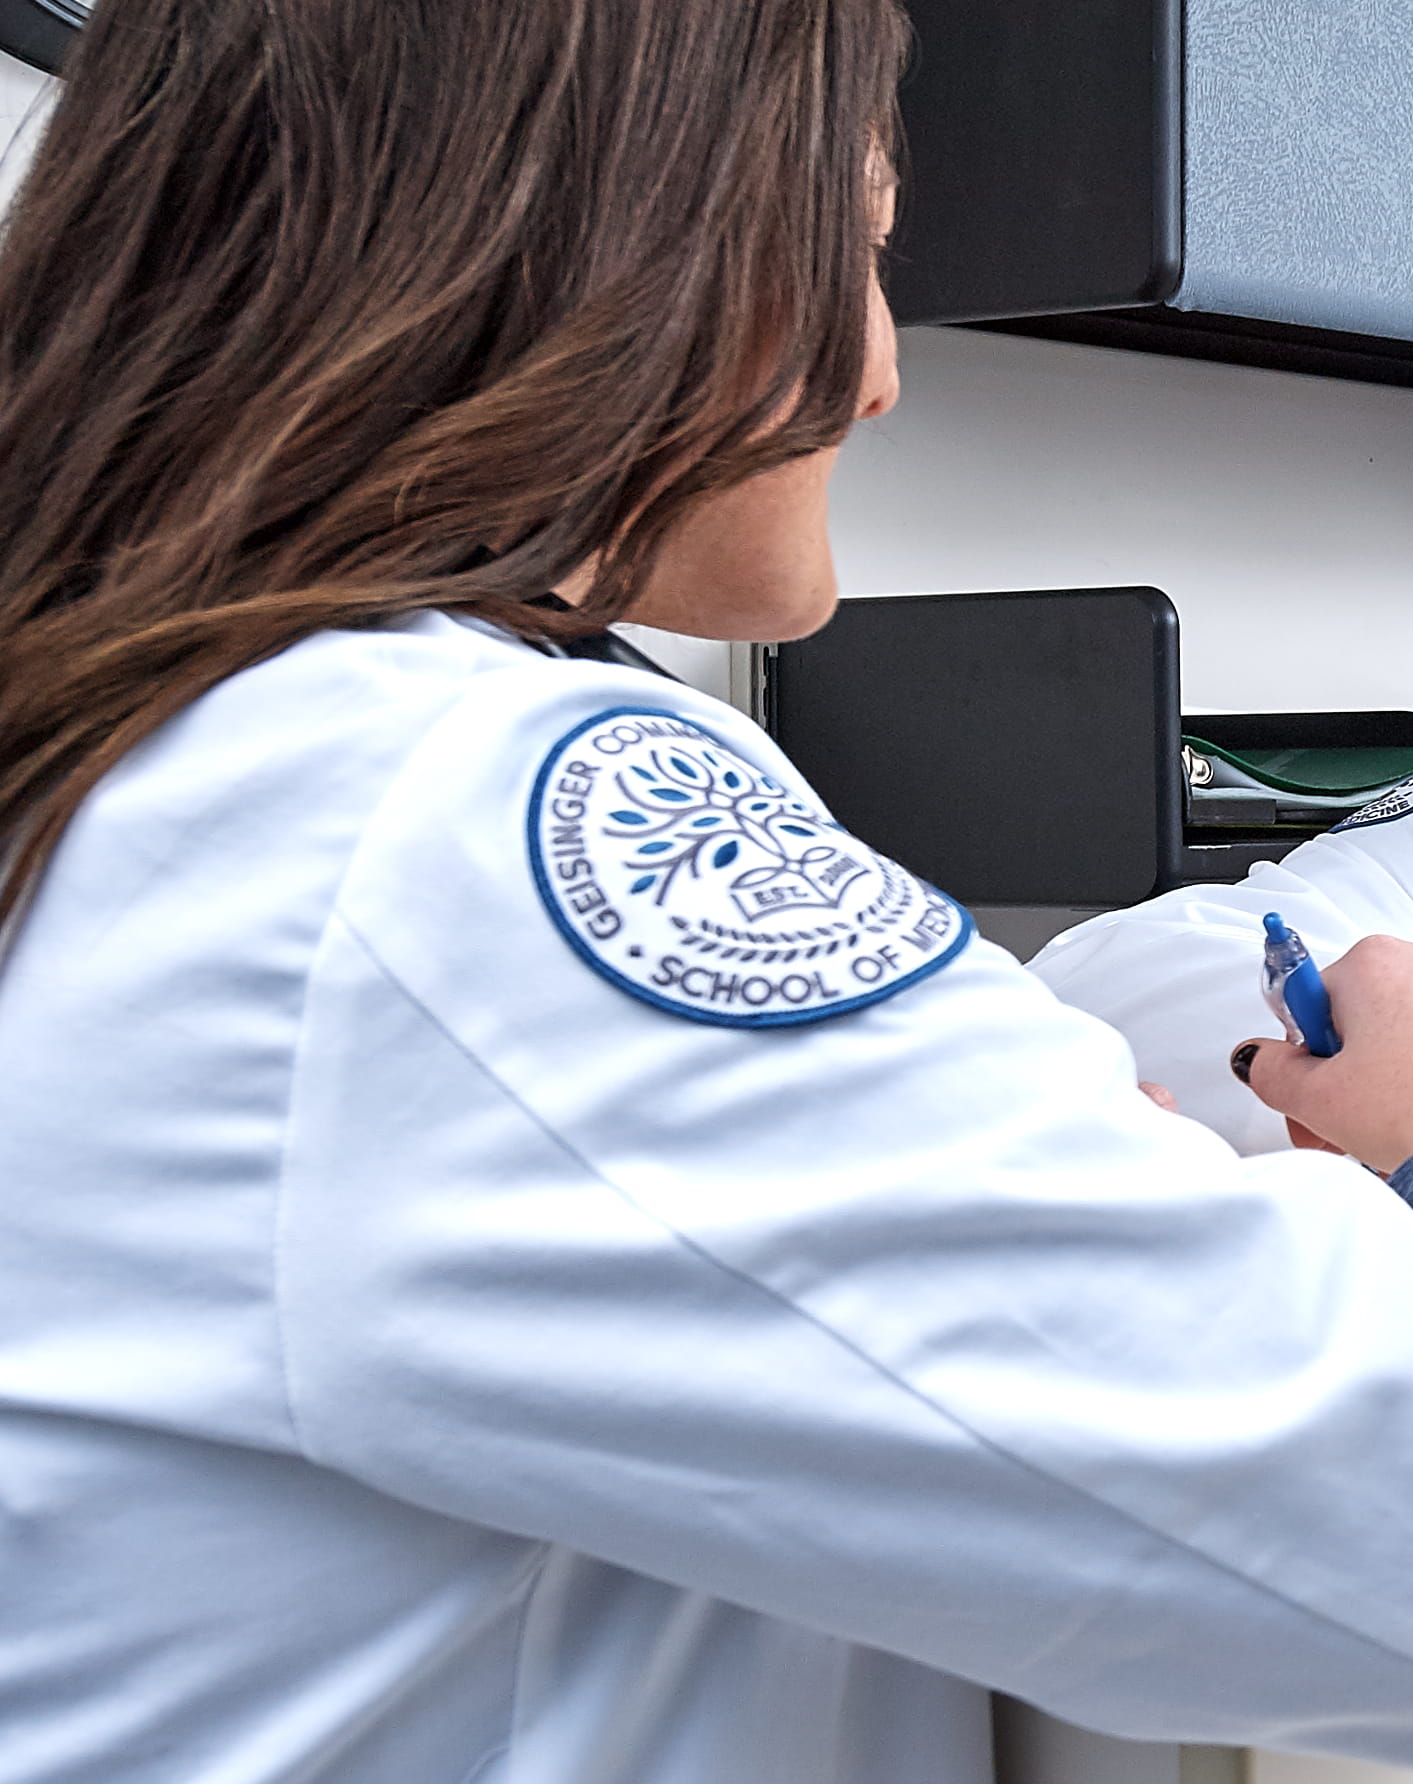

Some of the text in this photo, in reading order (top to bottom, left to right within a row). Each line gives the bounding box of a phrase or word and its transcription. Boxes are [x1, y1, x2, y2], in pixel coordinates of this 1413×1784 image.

[552, 760, 621, 940] GEISINGER
[650, 954, 842, 1006] SCHOOL
[853, 943, 904, 985] OF
